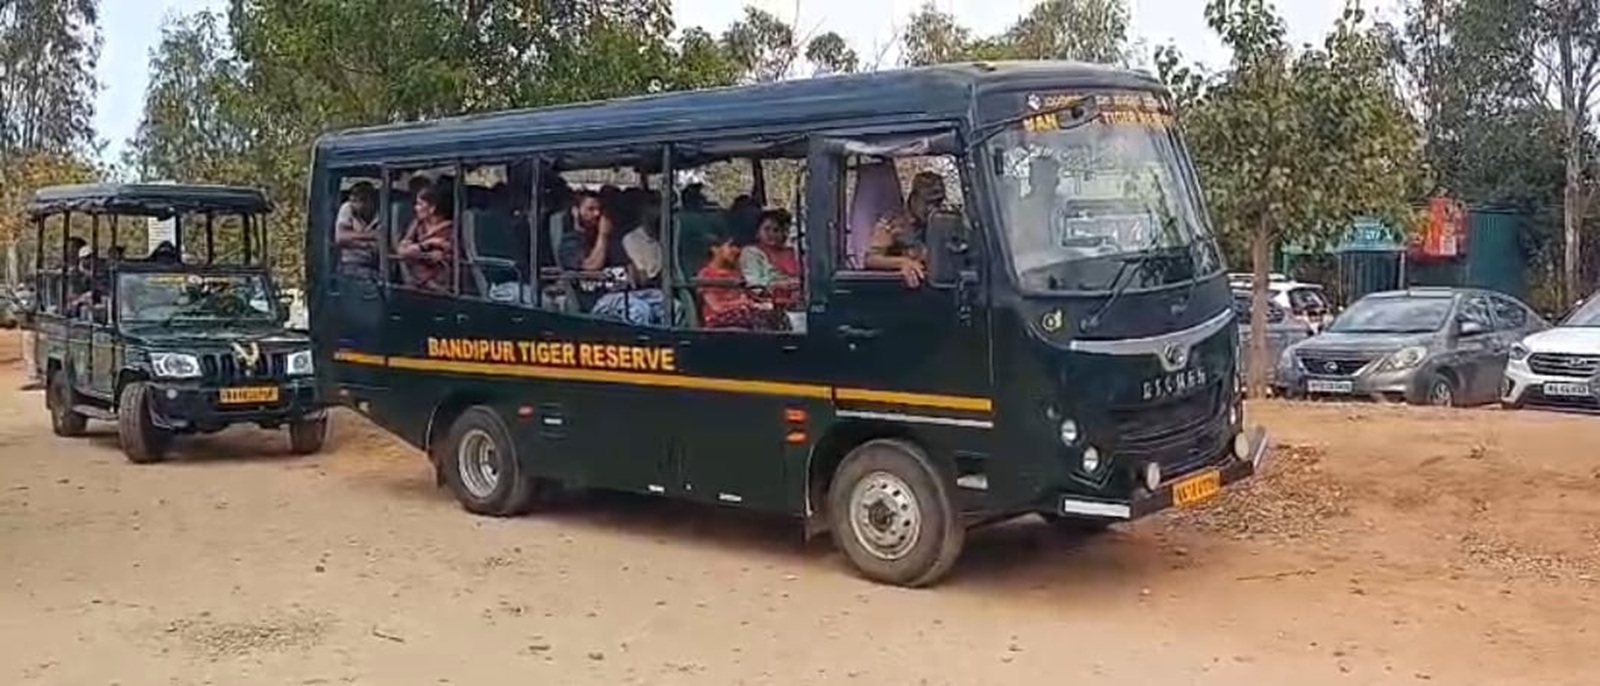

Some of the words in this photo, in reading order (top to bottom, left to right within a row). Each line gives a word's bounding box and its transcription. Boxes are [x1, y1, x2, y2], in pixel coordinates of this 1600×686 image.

[428, 337, 515, 362] BANDIPUR
[517, 341, 577, 365] TIGER
[580, 344, 676, 370] RESERVE
